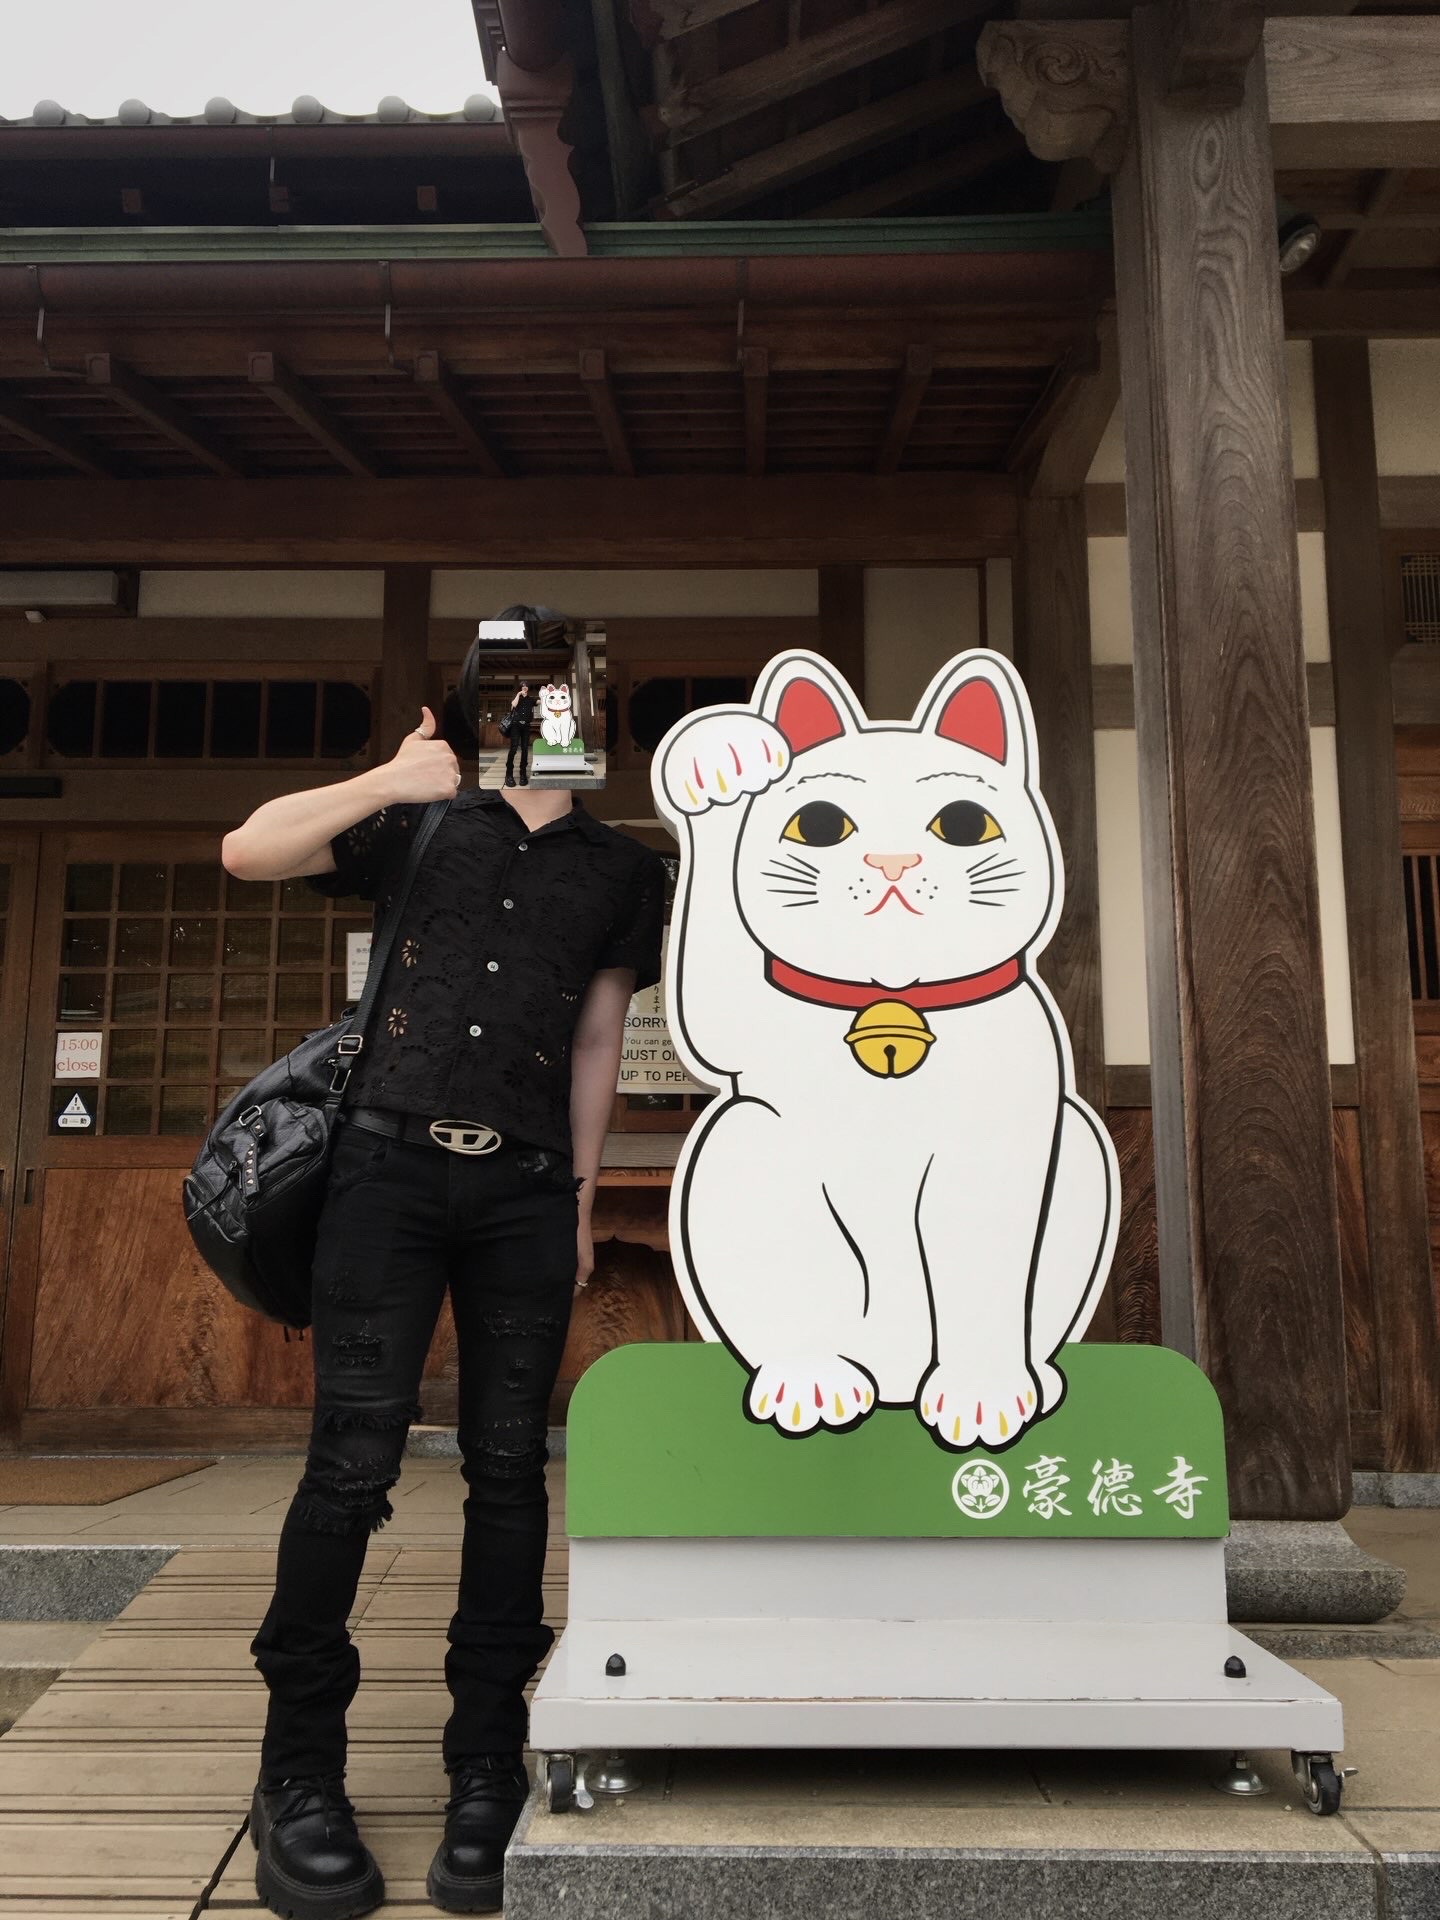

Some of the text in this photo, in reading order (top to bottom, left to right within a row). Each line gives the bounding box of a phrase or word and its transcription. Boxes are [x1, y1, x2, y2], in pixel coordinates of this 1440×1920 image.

[624, 1017, 668, 1028] SORRY
[60, 1039, 98, 1051] 15:00
[624, 1037, 641, 1045] You
[622, 1049, 676, 1061] JUST O
[57, 1057, 97, 1072] close
[621, 1070, 639, 1081] UP
[644, 1071, 661, 1081] TO
